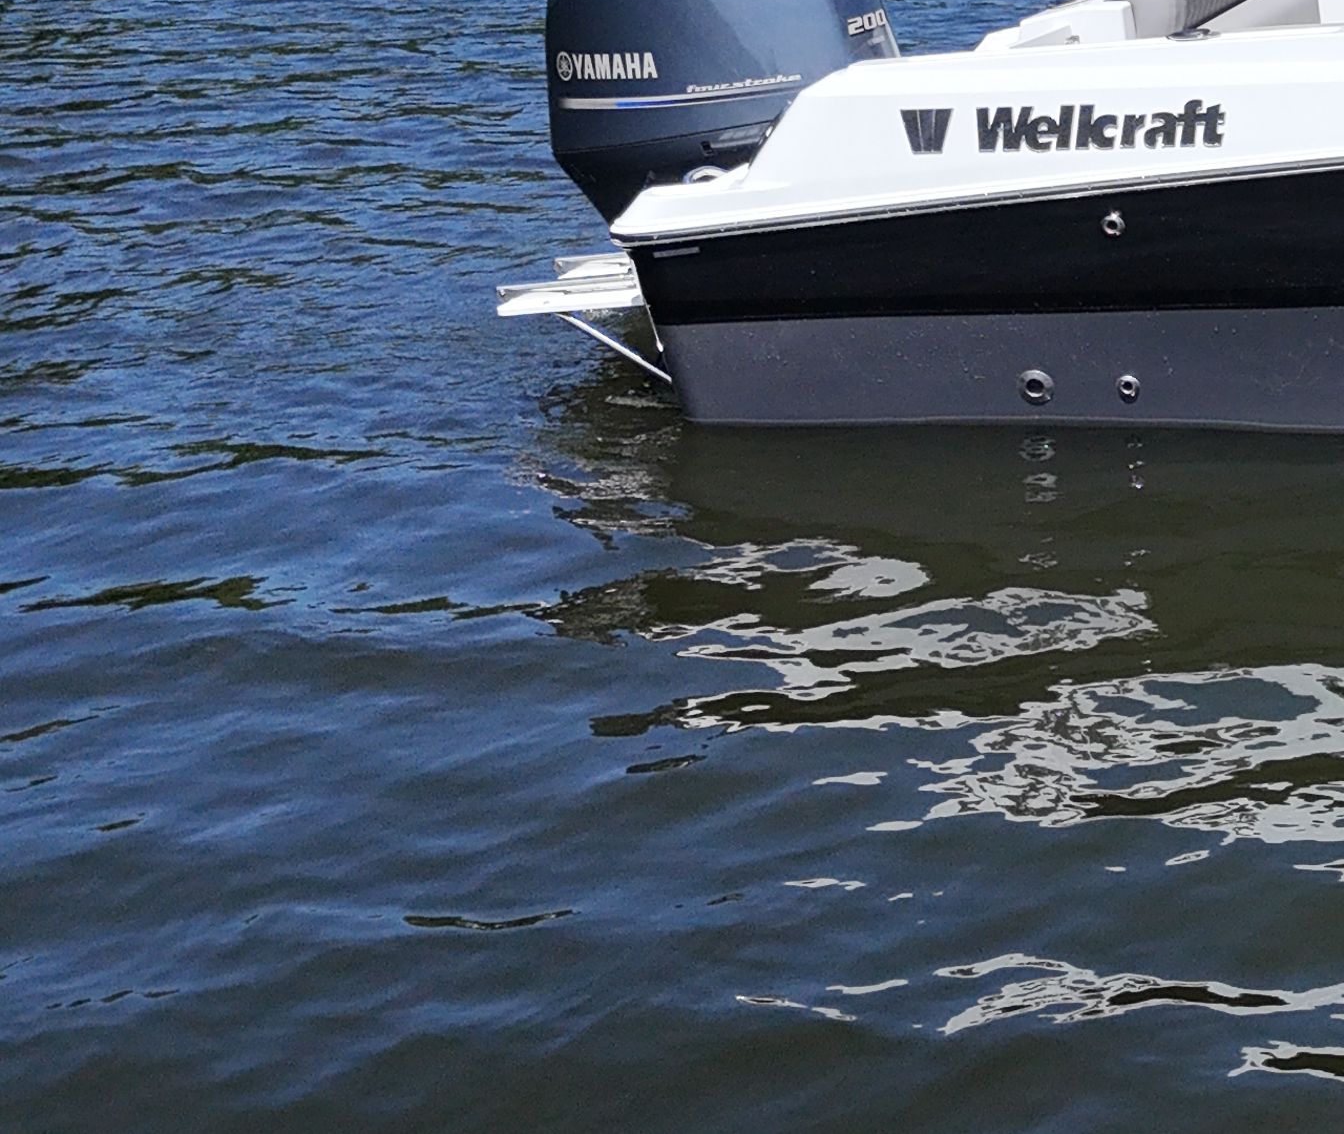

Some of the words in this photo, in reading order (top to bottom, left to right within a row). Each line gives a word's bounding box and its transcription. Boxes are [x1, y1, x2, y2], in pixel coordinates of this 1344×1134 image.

[847, 8, 887, 36] 200
[571, 52, 658, 80] YAMAHA
[975, 99, 1226, 153] Wellcraft
